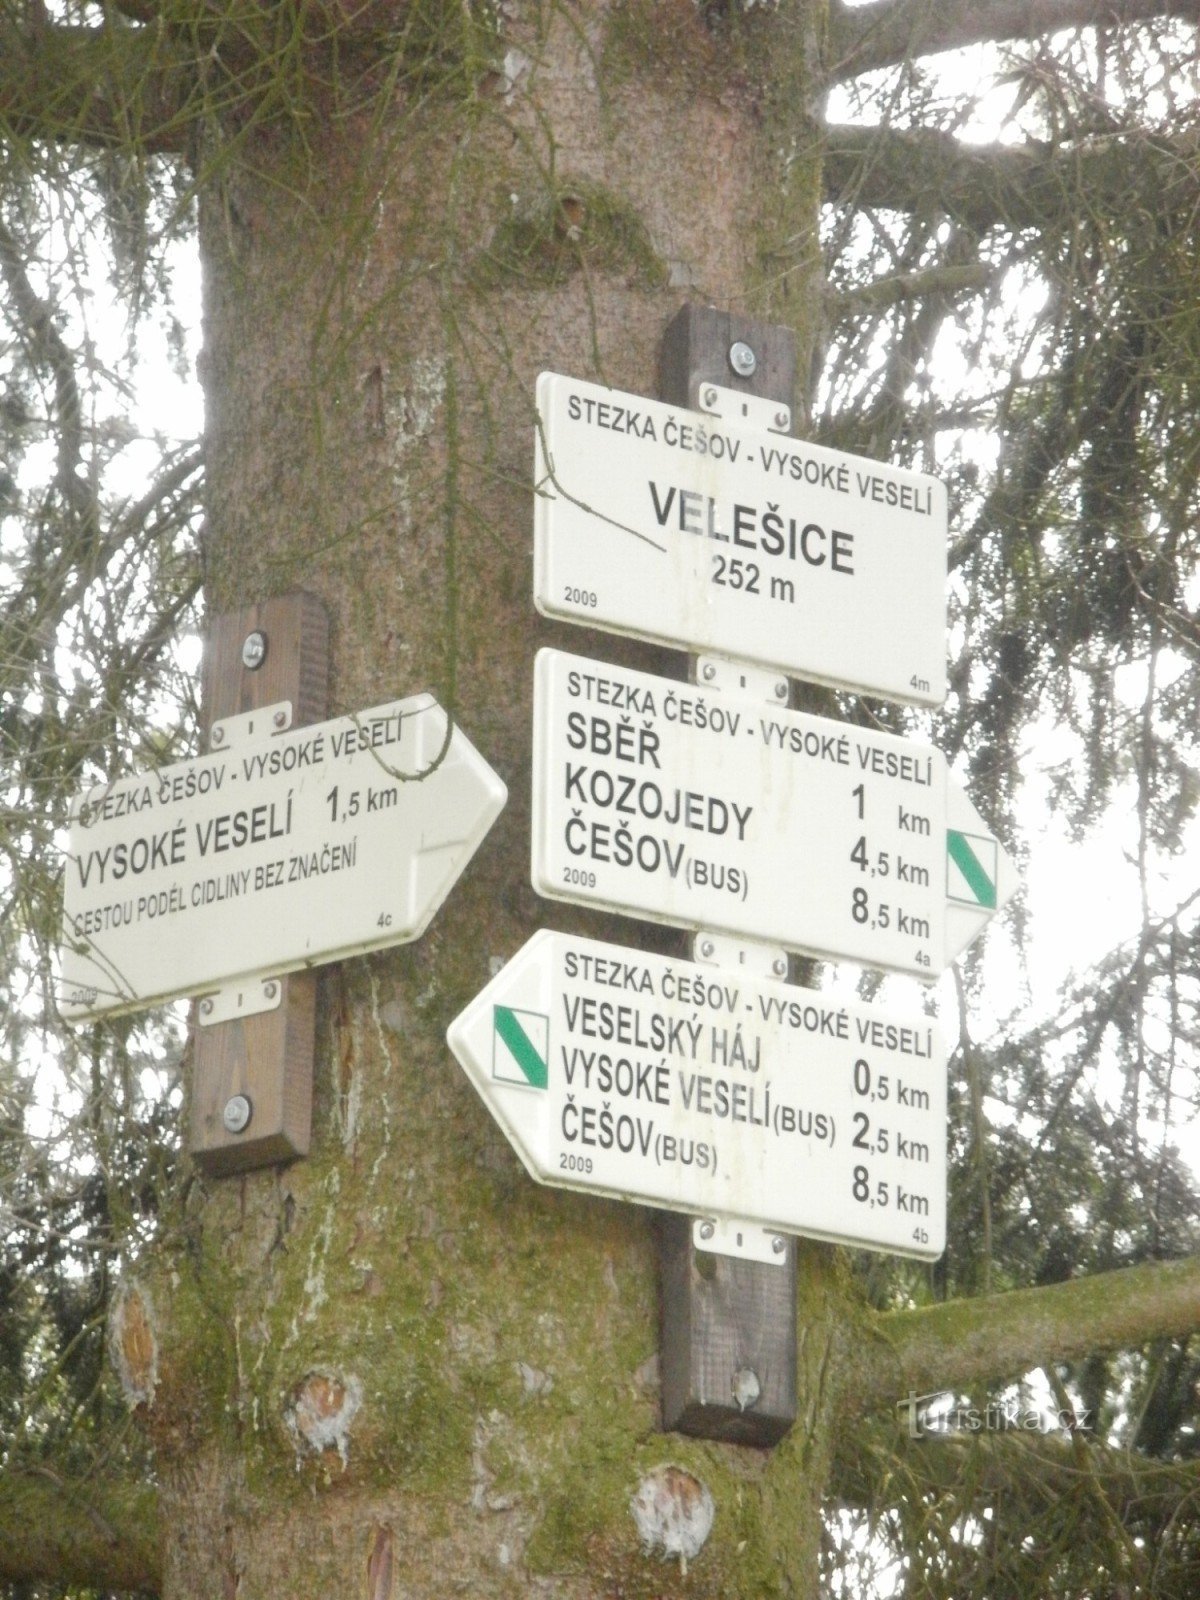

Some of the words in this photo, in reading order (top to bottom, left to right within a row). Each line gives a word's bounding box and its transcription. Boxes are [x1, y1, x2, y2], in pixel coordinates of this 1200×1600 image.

[567, 394, 657, 442] STEZKA
[662, 414, 740, 463] ČEŠOV
[760, 446, 849, 494] VYSOKÉ
[856, 472, 932, 516] VESELÍ
[648, 480, 855, 576] VELEŠICE
[564, 586, 598, 608] 2009
[712, 554, 760, 595] 252
[771, 577, 795, 603] m
[909, 674, 930, 693] 4m
[566, 711, 661, 769] SBĚŘ
[567, 672, 657, 717] STEZKA
[663, 690, 740, 737] ČEŠOV
[760, 719, 850, 765] VYSOKÉ
[856, 743, 932, 786] VESELÍ
[79, 786, 153, 827] TEZKA
[159, 765, 226, 805] ČEŠOV
[243, 733, 324, 781] VYSOKÉ
[331, 710, 402, 758] VESELÍ
[564, 761, 753, 841] KOZOJEDY
[852, 784, 865, 820] 1
[898, 805, 931, 836] km
[77, 819, 186, 889] VYSOKÉ
[196, 789, 293, 857] VESELÍ
[326, 785, 360, 824] 1,5
[367, 786, 397, 813] km
[850, 836, 889, 876] 4,5
[897, 855, 930, 886] km
[73, 899, 132, 938] CESTOU
[137, 888, 188, 921] PODÉL
[191, 867, 251, 907] CIDLINY
[254, 860, 284, 892] BEZ
[288, 836, 357, 883] ZNAČENÍ
[563, 867, 596, 888] 2009
[377, 913, 392, 928] 4c
[852, 887, 890, 929] 8,5
[897, 907, 930, 938] km
[914, 950, 931, 967] 4a
[564, 952, 654, 996] STEZKA
[661, 967, 738, 1014] ČEŠOV
[759, 994, 849, 1040] VYSOKÉ
[856, 1016, 932, 1059] VESELÍ
[563, 994, 703, 1060] VESELSKÝ
[711, 1020, 761, 1074] HÁJ
[562, 1046, 670, 1105] VYSOKÉ
[852, 1059, 889, 1101] 0,5
[897, 1079, 930, 1110] km
[852, 1112, 889, 1154] 2,5
[897, 1131, 929, 1163] km
[559, 1153, 594, 1175] 2009
[852, 1165, 889, 1207] 8,5
[897, 1185, 929, 1216] km
[912, 1226, 930, 1245] 4b
